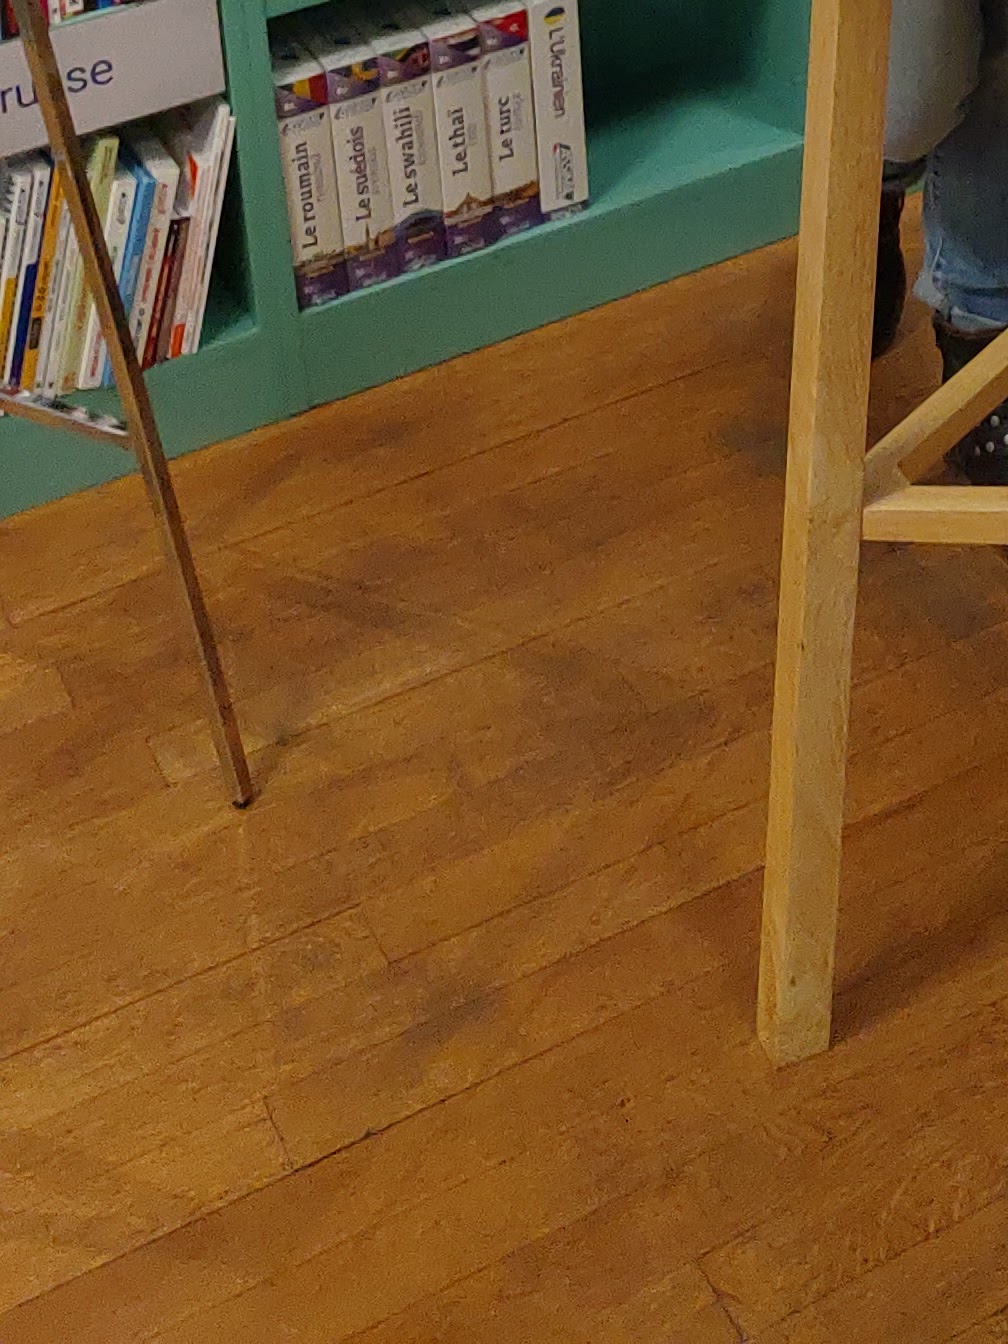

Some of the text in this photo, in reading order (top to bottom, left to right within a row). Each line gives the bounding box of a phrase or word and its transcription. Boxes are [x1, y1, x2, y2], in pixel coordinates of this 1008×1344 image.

[0, 58, 114, 115] ruse
[498, 95, 514, 162] Le turc
[346, 125, 372, 222] Le suédois
[392, 105, 419, 208] Le swahili
[448, 105, 469, 177] Le thaï
[291, 141, 318, 249] Le roumain
